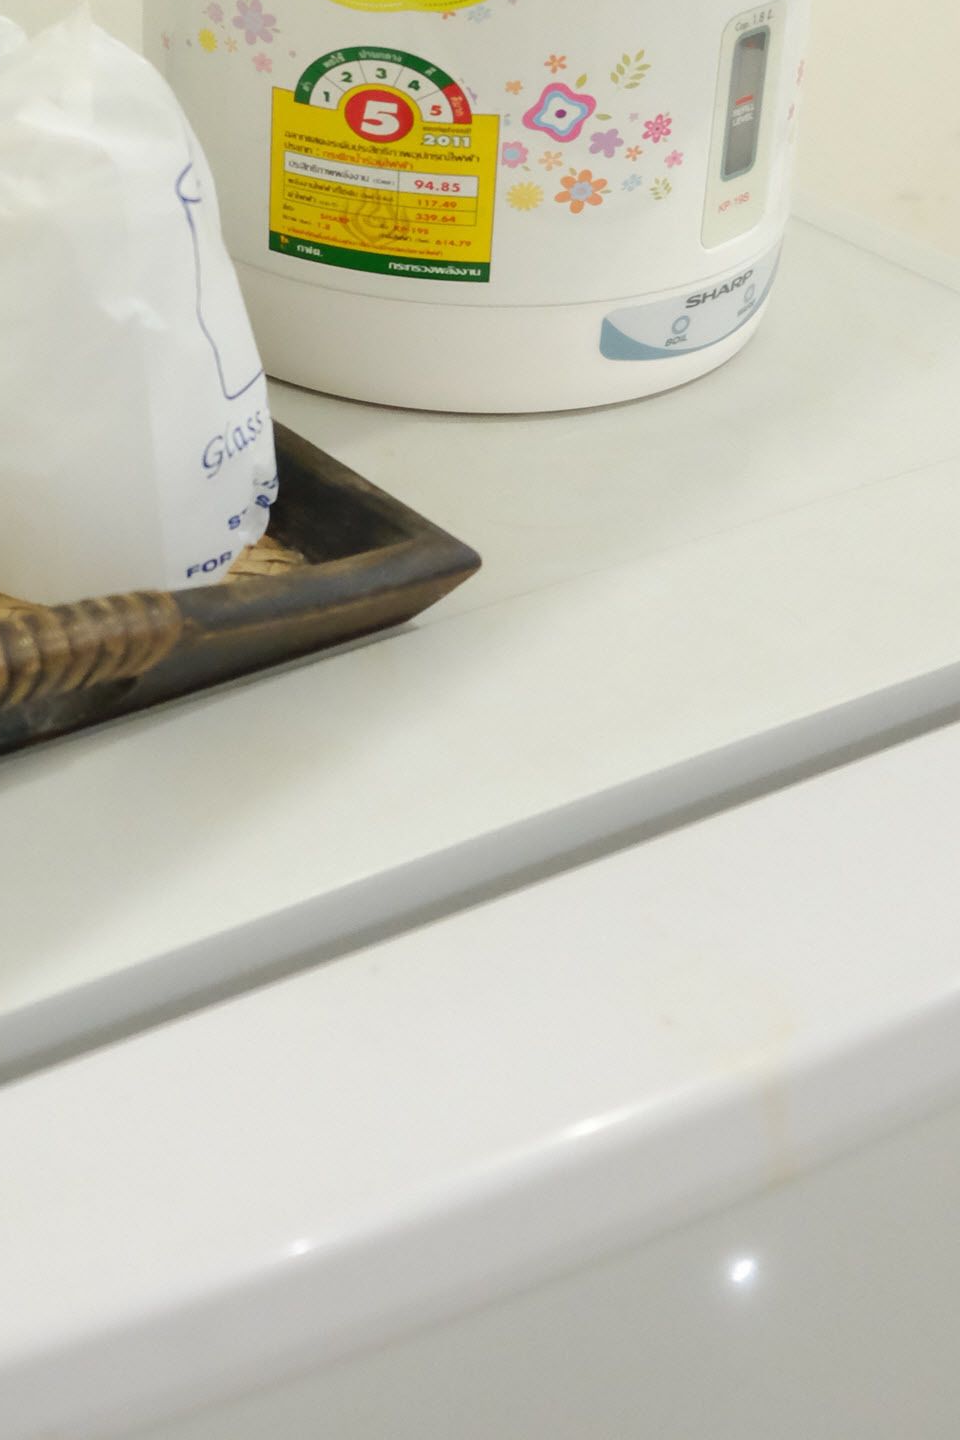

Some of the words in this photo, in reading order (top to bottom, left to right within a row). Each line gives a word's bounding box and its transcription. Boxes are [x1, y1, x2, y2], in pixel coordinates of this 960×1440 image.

[322, 90, 331, 103] 1
[341, 71, 353, 84] 2
[375, 68, 388, 80] 3
[407, 79, 421, 91] 4
[429, 104, 443, 116] 5
[360, 100, 401, 136] 5
[422, 133, 472, 149] 2011
[414, 179, 461, 193] 94.85
[685, 268, 754, 309] SHARP
[201, 410, 263, 480] Glass
